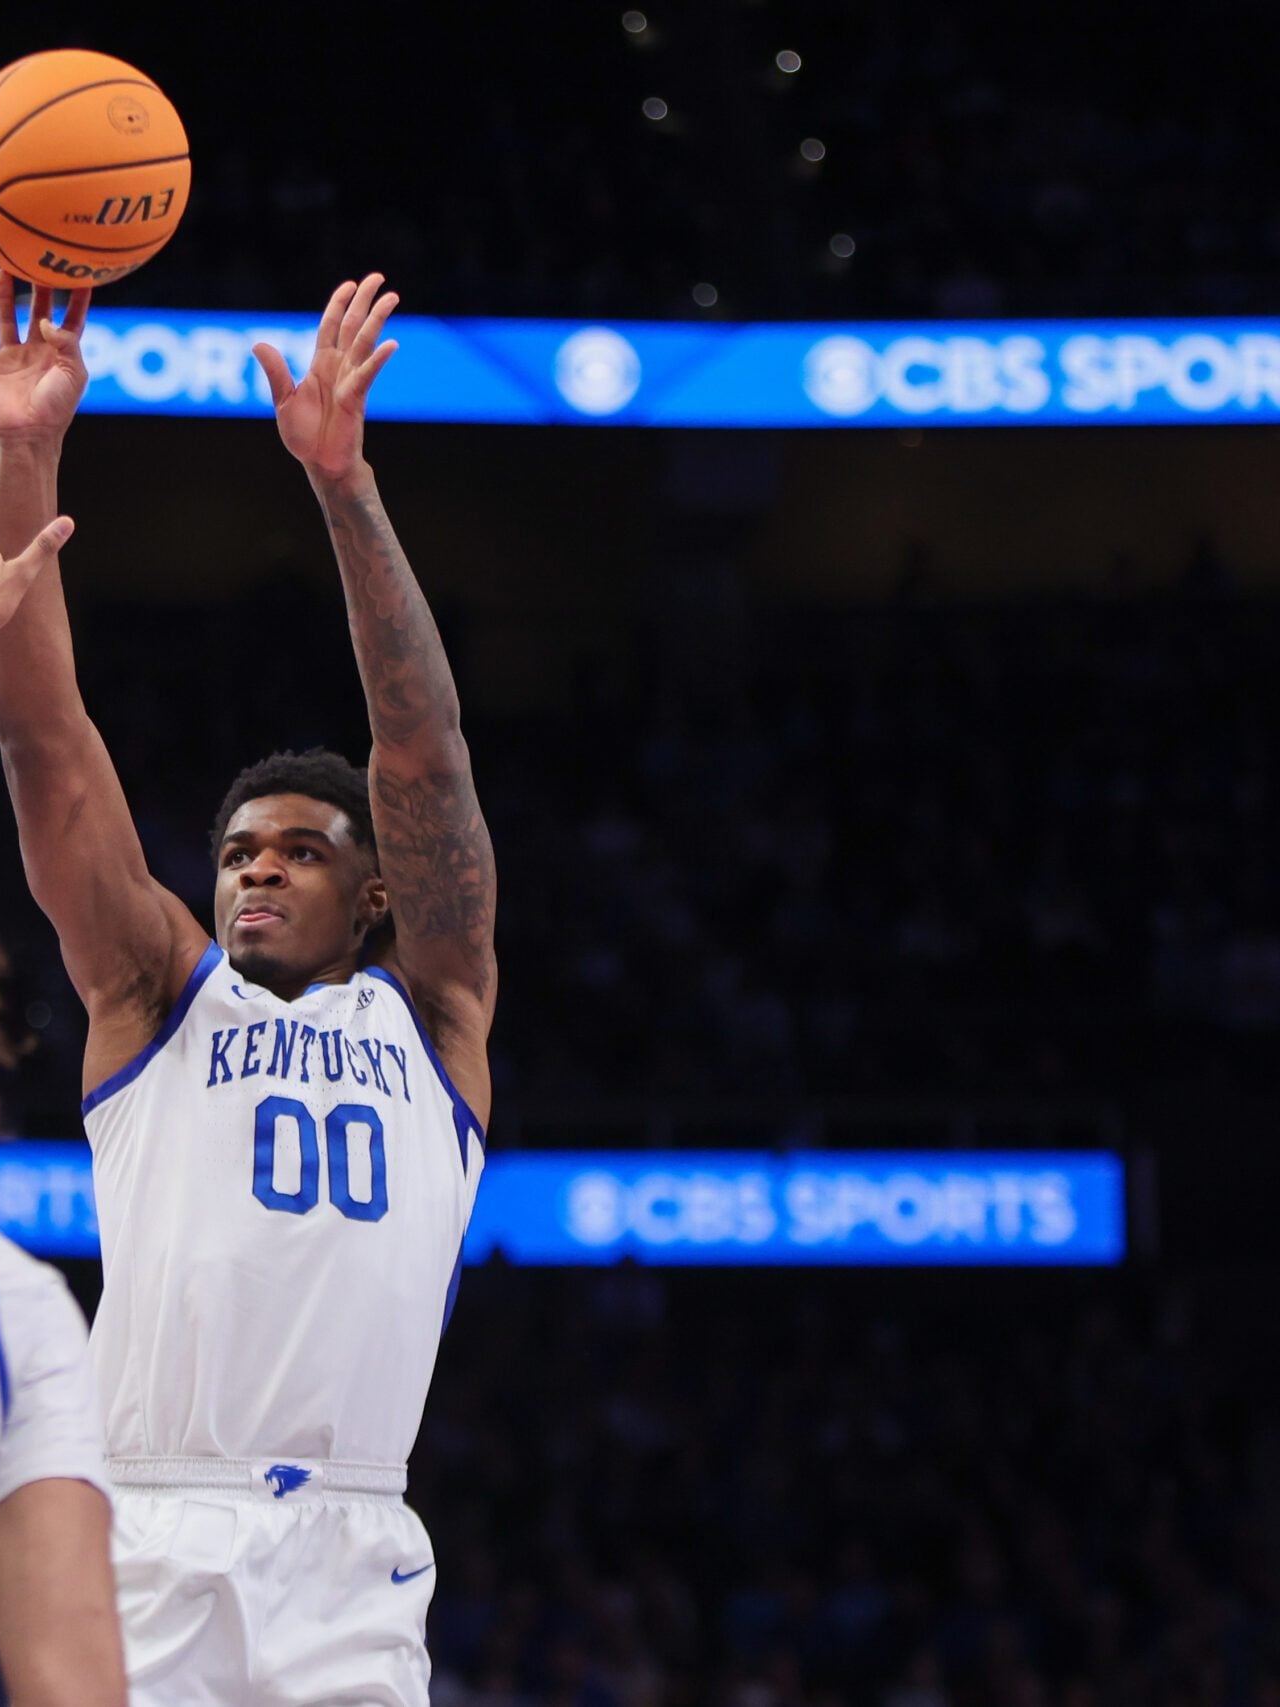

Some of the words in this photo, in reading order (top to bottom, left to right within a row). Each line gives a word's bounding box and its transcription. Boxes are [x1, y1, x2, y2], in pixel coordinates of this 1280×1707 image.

[881, 334, 1051, 414] CBS
[206, 1018, 411, 1104] KENTUCKY
[252, 1095, 389, 1222] 00
[631, 1169, 777, 1246] CBS
[784, 1169, 1078, 1246] SPORTS
